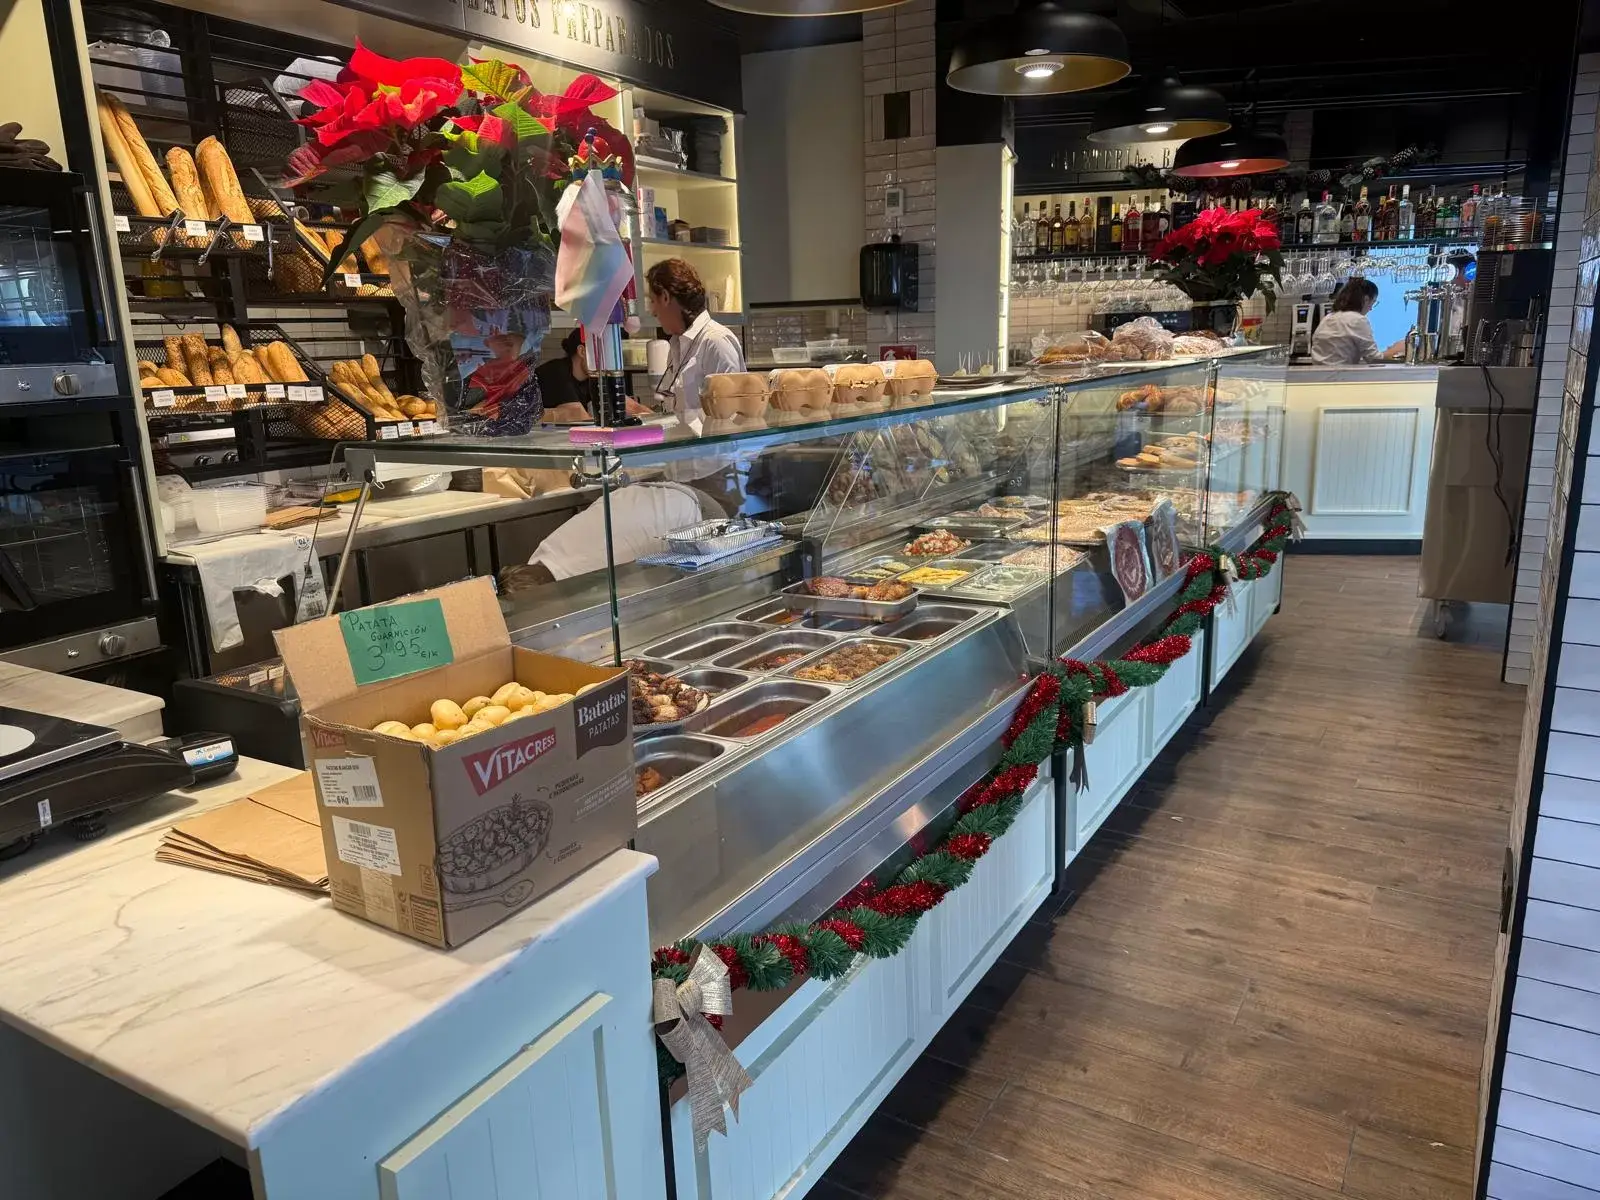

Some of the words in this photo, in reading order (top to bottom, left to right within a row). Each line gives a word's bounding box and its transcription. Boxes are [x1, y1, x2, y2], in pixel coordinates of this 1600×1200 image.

[344, 611, 398, 631] PATATA
[577, 690, 626, 727] Batatas
[588, 712, 621, 739] PATATAS
[473, 733, 556, 790] VITACRESS
